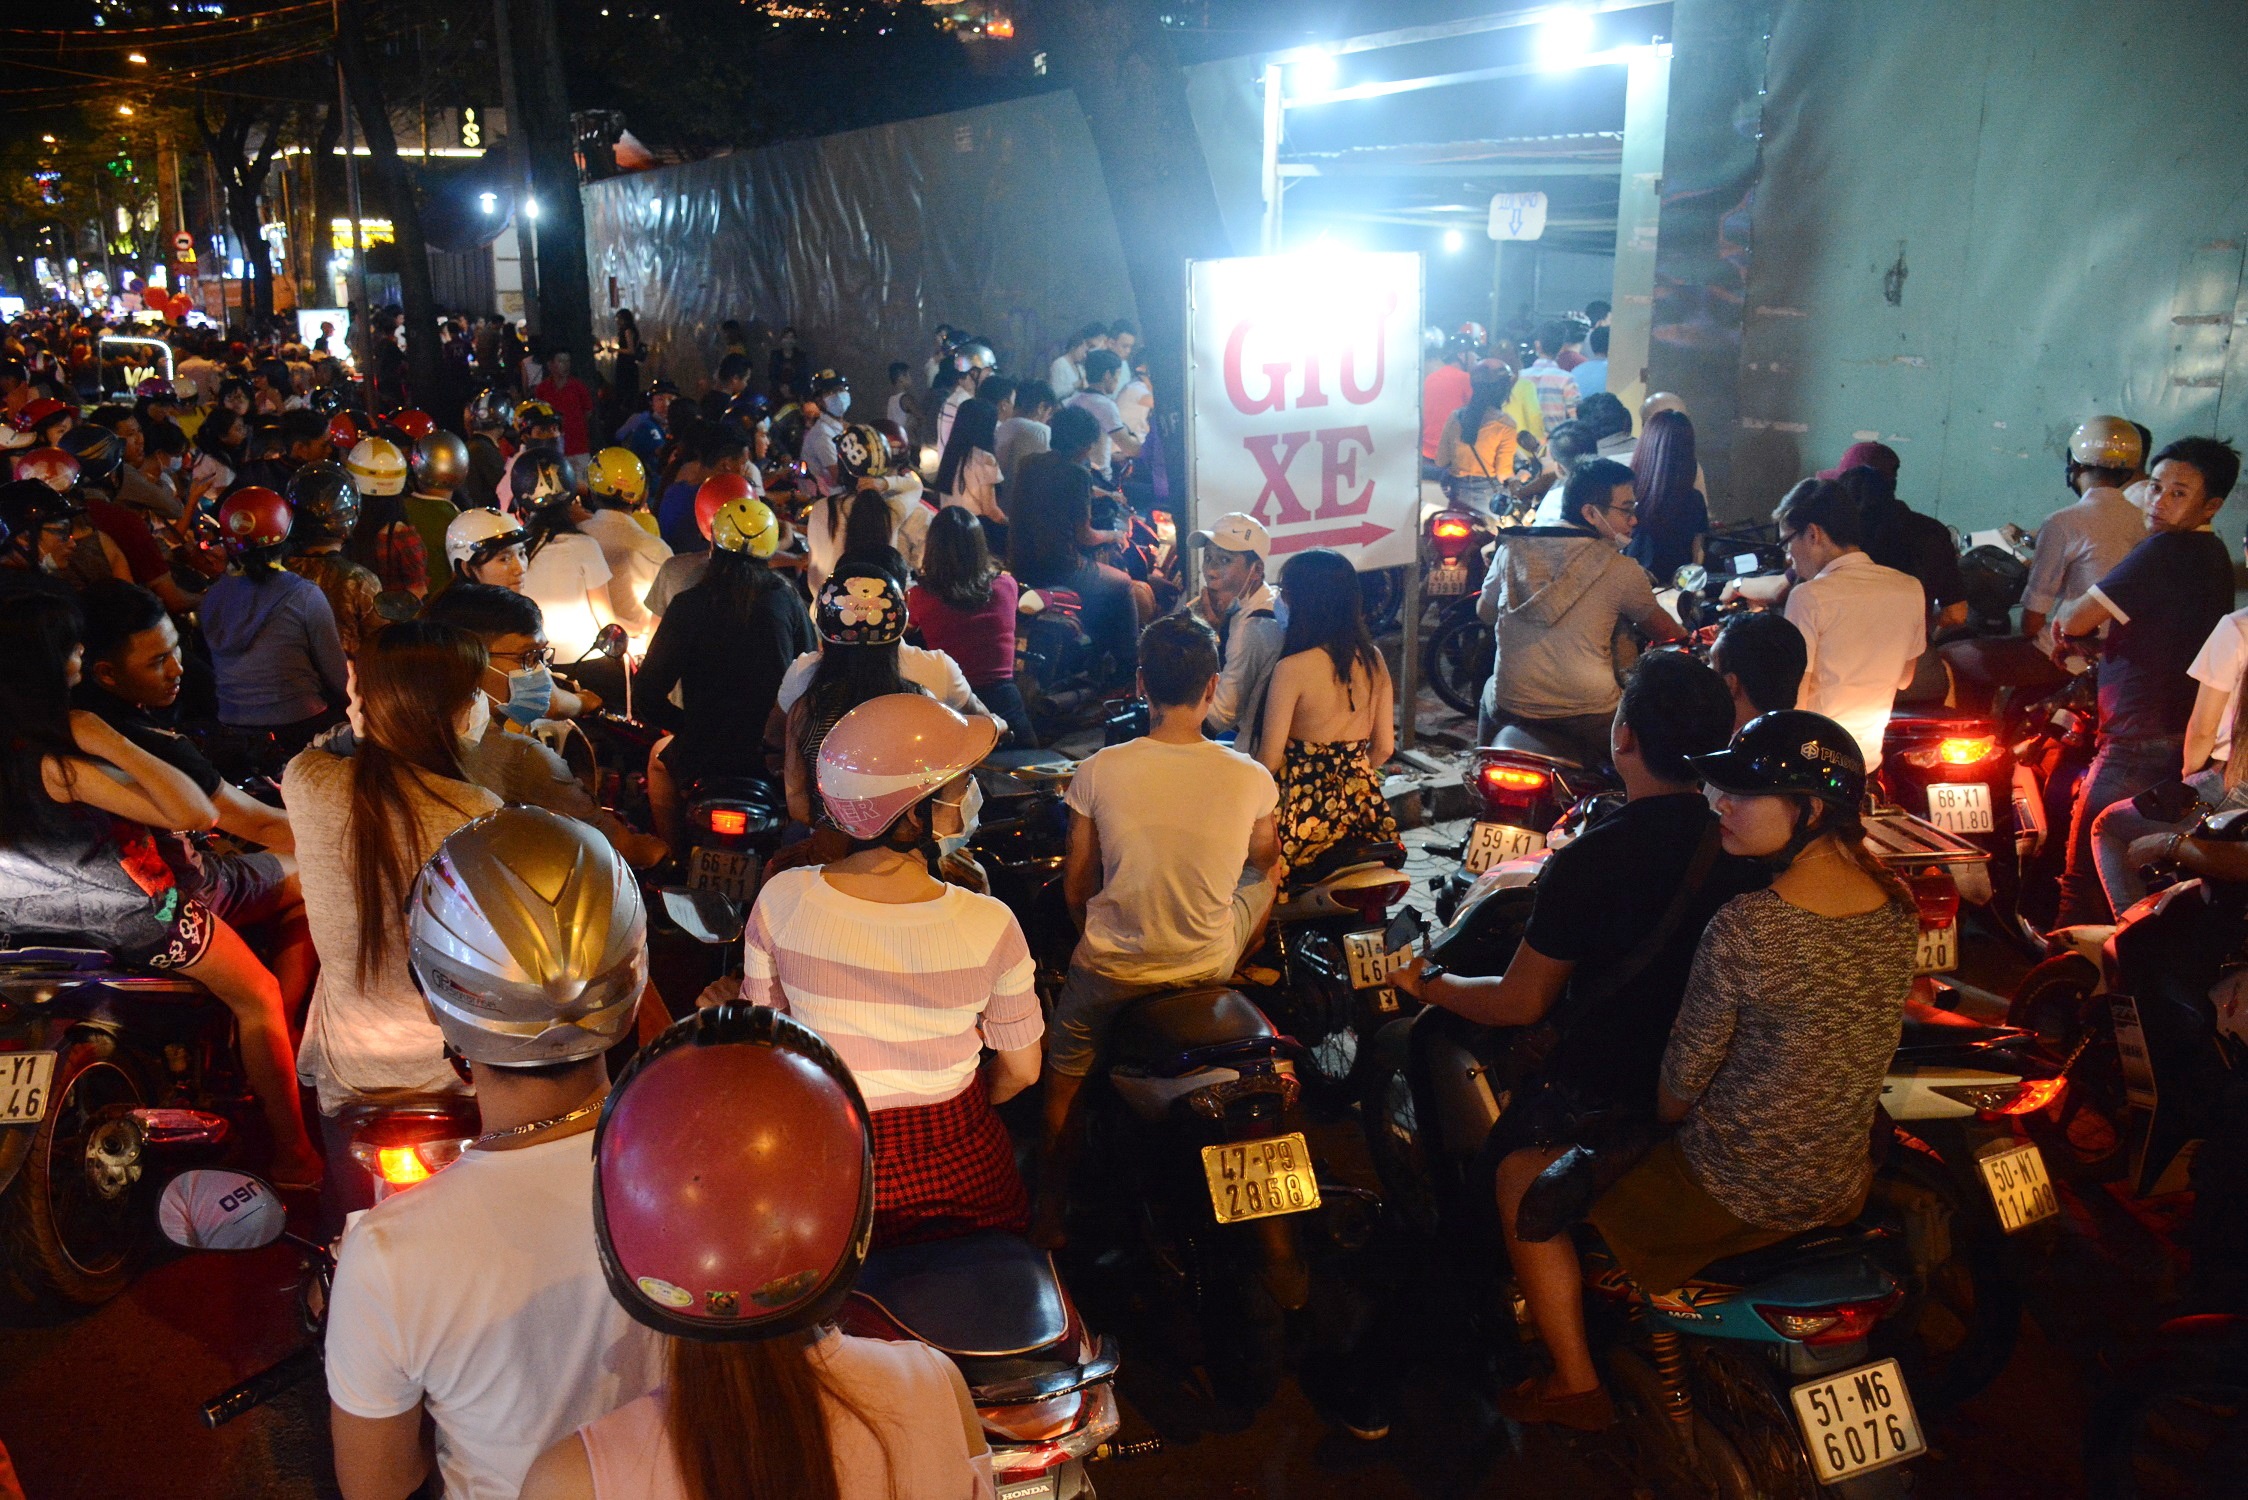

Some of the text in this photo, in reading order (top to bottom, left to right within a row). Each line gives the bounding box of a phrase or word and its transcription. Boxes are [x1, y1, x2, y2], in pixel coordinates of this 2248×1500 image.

[1243, 424, 1376, 527] XE
[1482, 828, 1531, 855] 59-K1
[1220, 1142, 1296, 1181] 47-P9
[1226, 1174, 1304, 1217] 2858
[1808, 1371, 1892, 1427] 51-M6
[1824, 1413, 1907, 1472] 6076
[1002, 1485, 1050, 1500] HONDA
